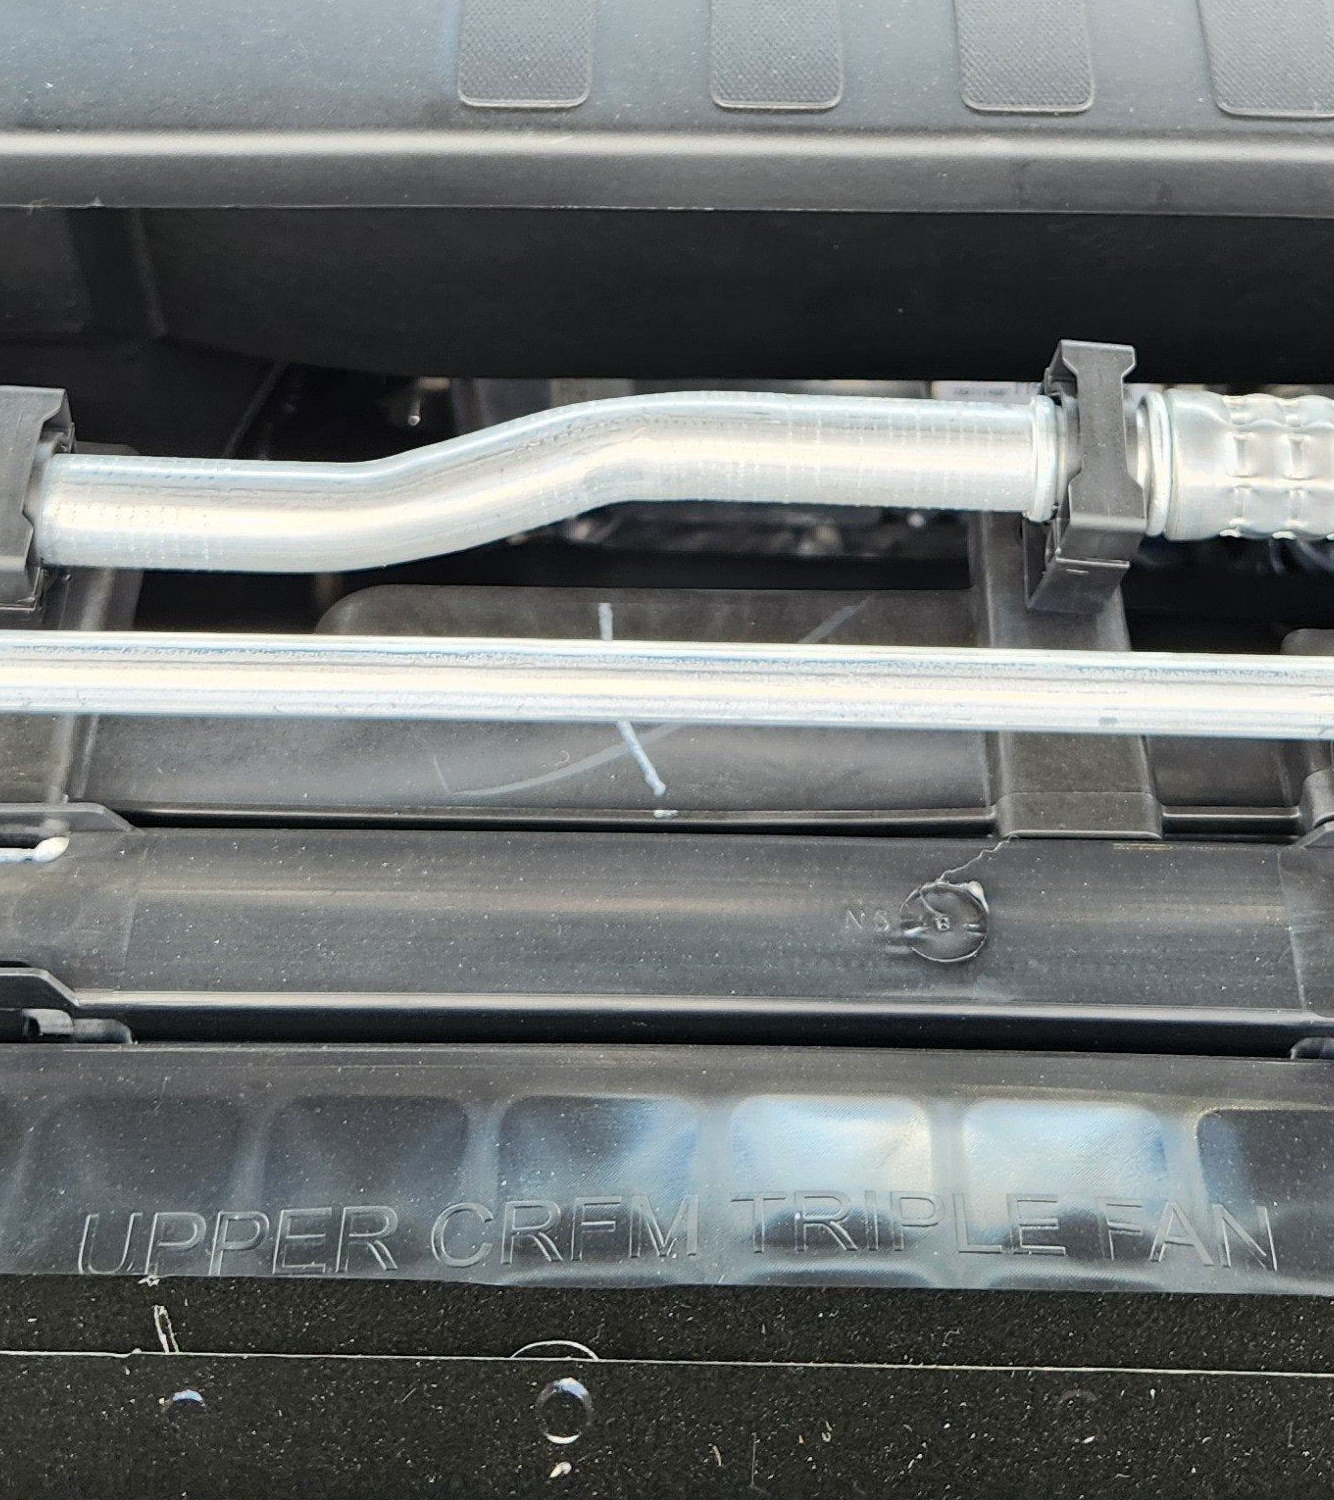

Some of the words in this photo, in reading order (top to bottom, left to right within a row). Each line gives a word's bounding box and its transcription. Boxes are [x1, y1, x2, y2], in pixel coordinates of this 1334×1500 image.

[78, 1205, 400, 1276] UPPER
[430, 1195, 701, 1268] CRFM
[731, 1190, 1067, 1255] TRIPLE
[1097, 1195, 1279, 1272] FAN
